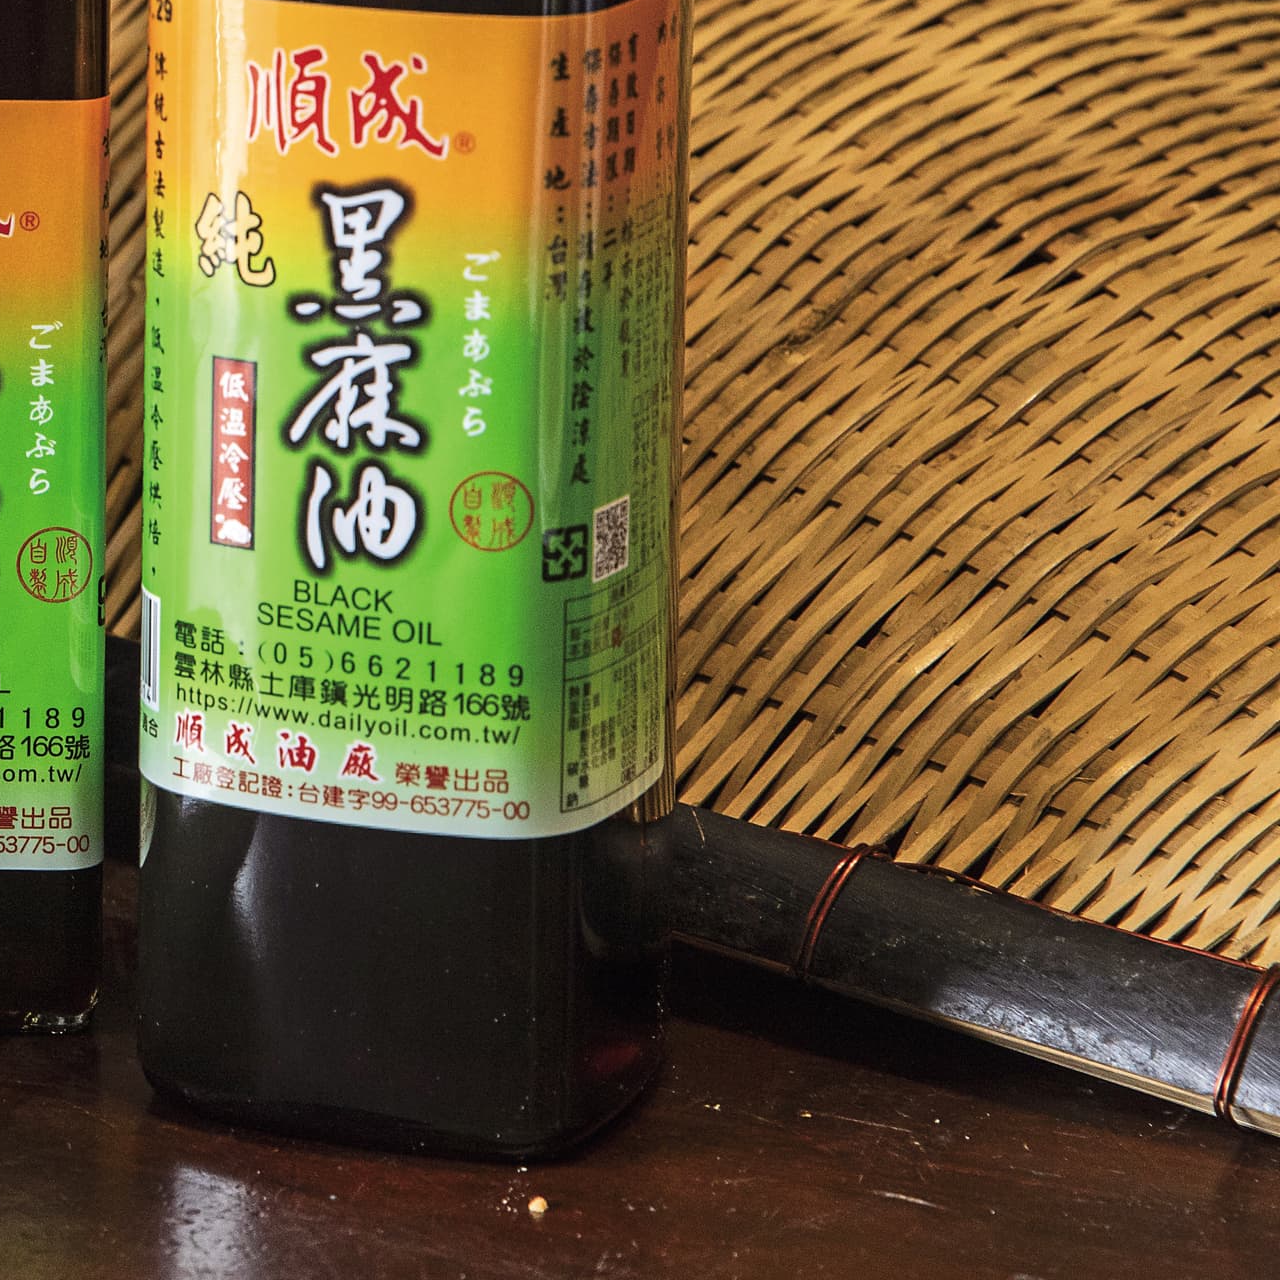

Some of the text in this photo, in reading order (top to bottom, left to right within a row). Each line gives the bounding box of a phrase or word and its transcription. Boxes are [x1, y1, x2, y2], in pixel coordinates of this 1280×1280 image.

[247, 46, 449, 159] 順成
[194, 190, 276, 287] 純
[459, 251, 502, 437] ごまあぶら
[26, 321, 63, 496] ごまあぶら
[257, 602, 443, 646] SESAME OIL
[294, 580, 393, 614] BLACK
[176, 683, 521, 745] https://www.dailyoil.com.tw/
